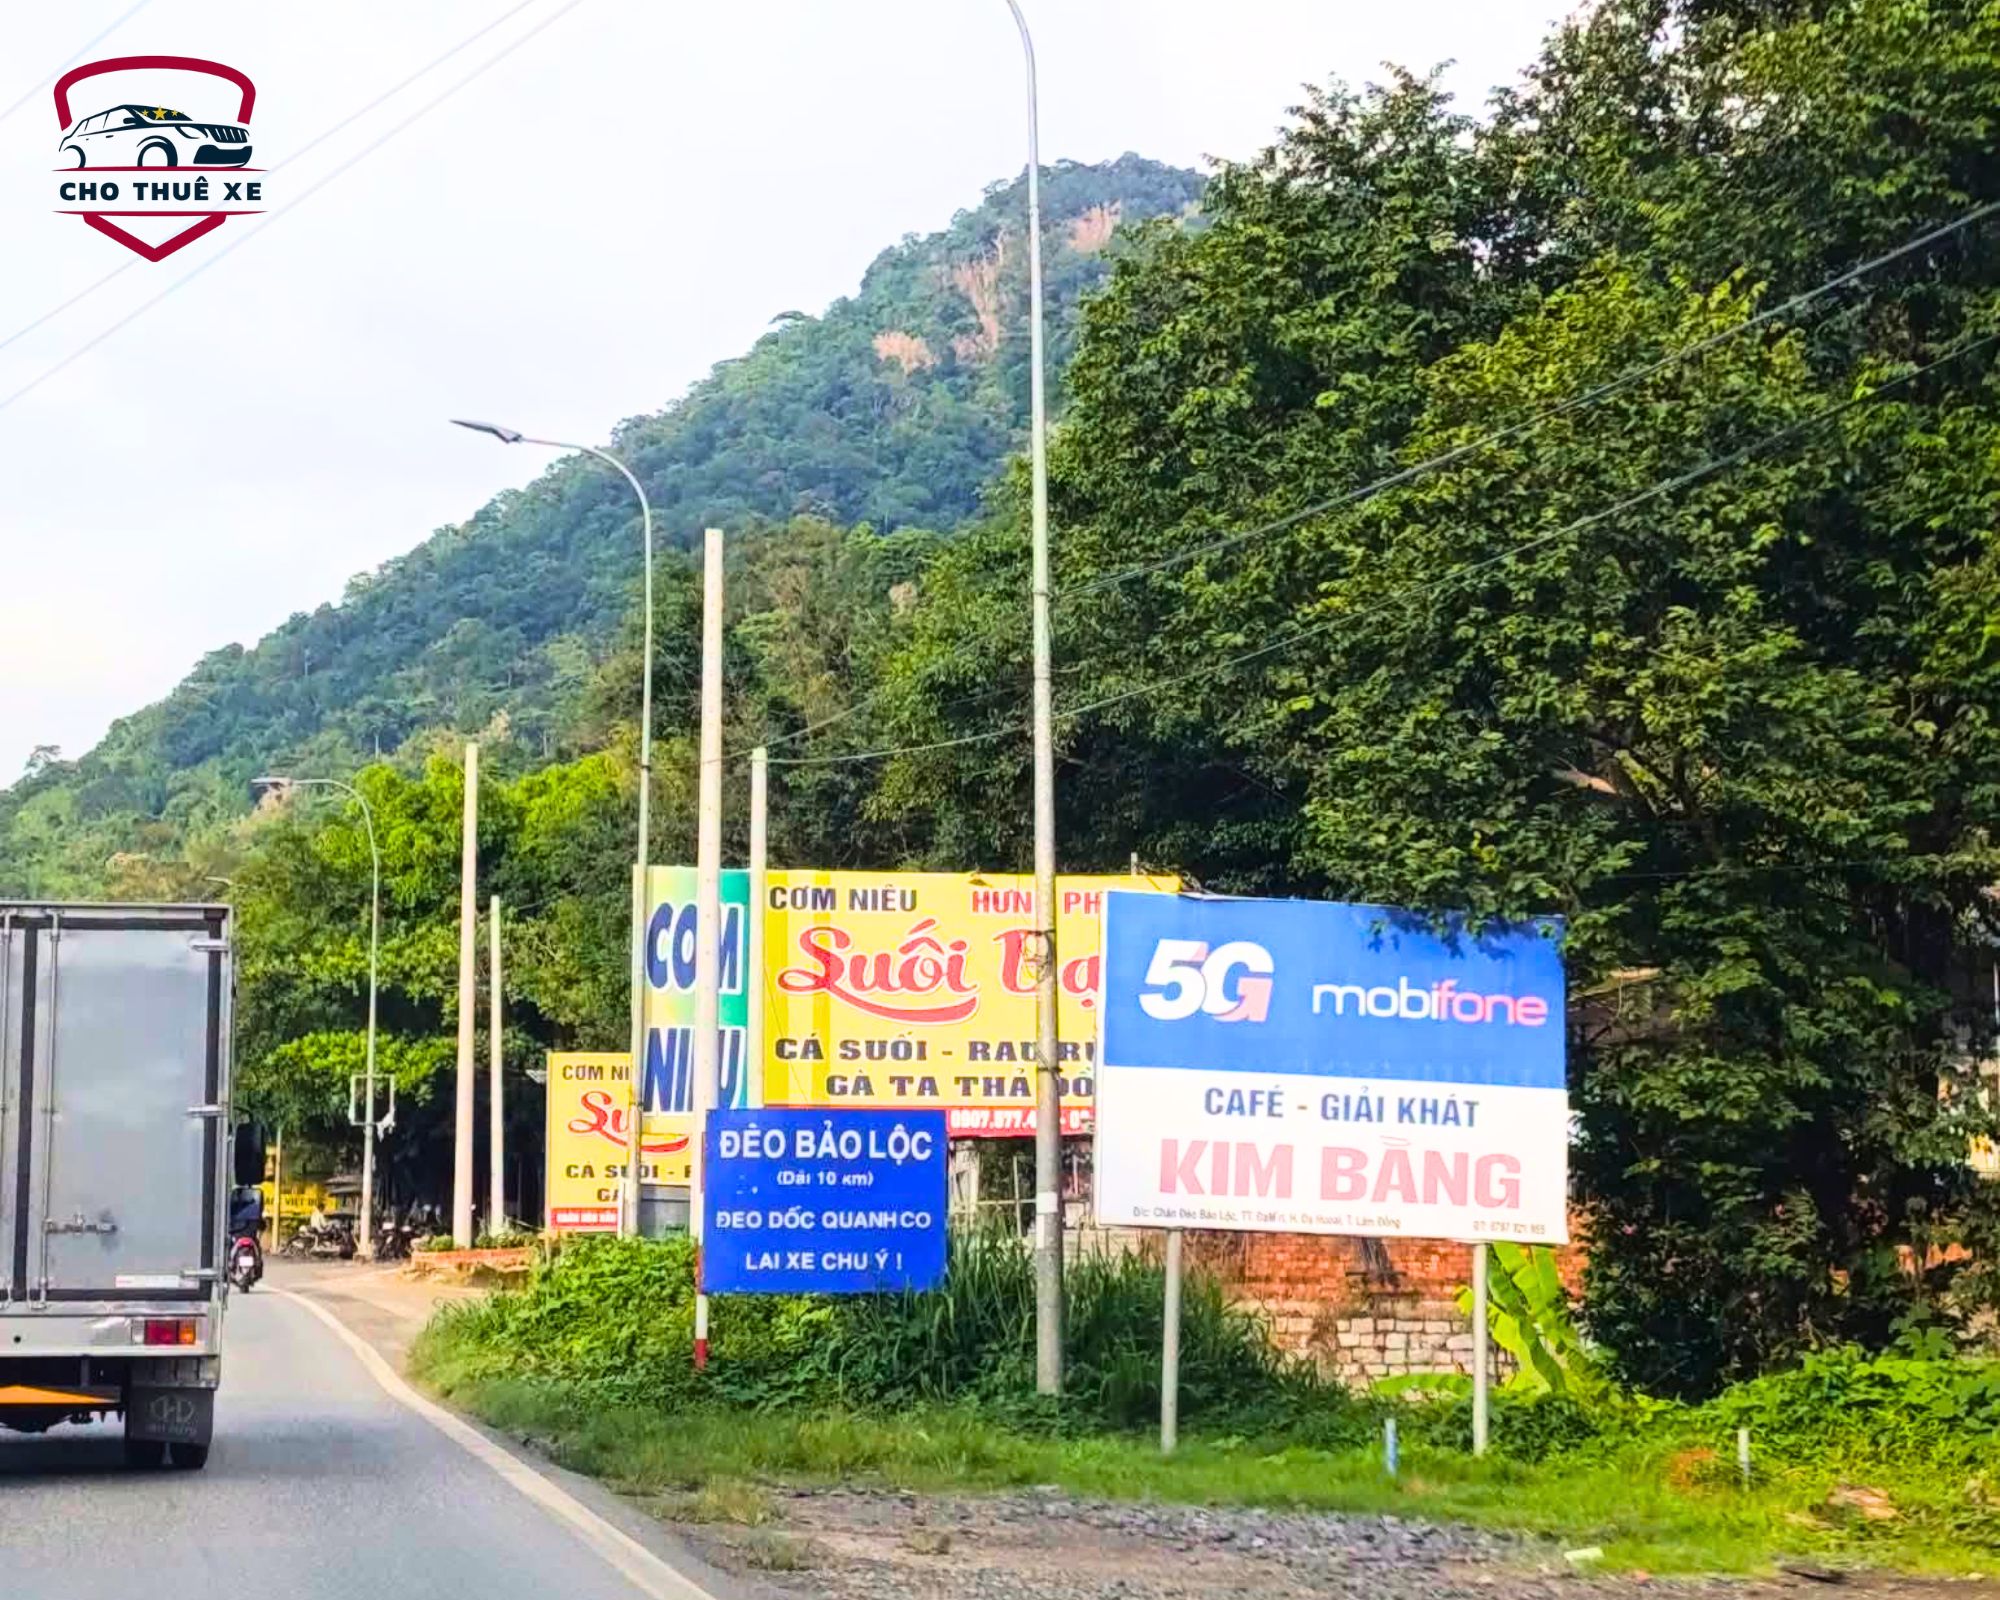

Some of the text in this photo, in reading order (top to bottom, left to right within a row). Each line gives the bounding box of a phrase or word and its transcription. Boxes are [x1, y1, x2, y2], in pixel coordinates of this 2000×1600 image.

[769, 885, 837, 911] CƠM
[778, 918, 977, 1023] Suối
[1139, 939, 1547, 1026] 5G mobifone
[775, 1032, 824, 1060] CÁ
[826, 1069, 875, 1096] GÀ
[889, 1076, 939, 1097] TA
[954, 1068, 1032, 1098] THẢ
[1321, 1085, 1385, 1123] GIẢI
[1397, 1093, 1480, 1128] KHÁT
[795, 1119, 862, 1159] BẢO
[869, 1124, 932, 1166] LỘC
[817, 1170, 837, 1186] 10
[1159, 1138, 1294, 1200] KIM
[768, 1205, 815, 1230] DỐC
[821, 1211, 897, 1230] QUANH
[785, 1252, 815, 1271] XE
[874, 1248, 889, 1270] Ý
